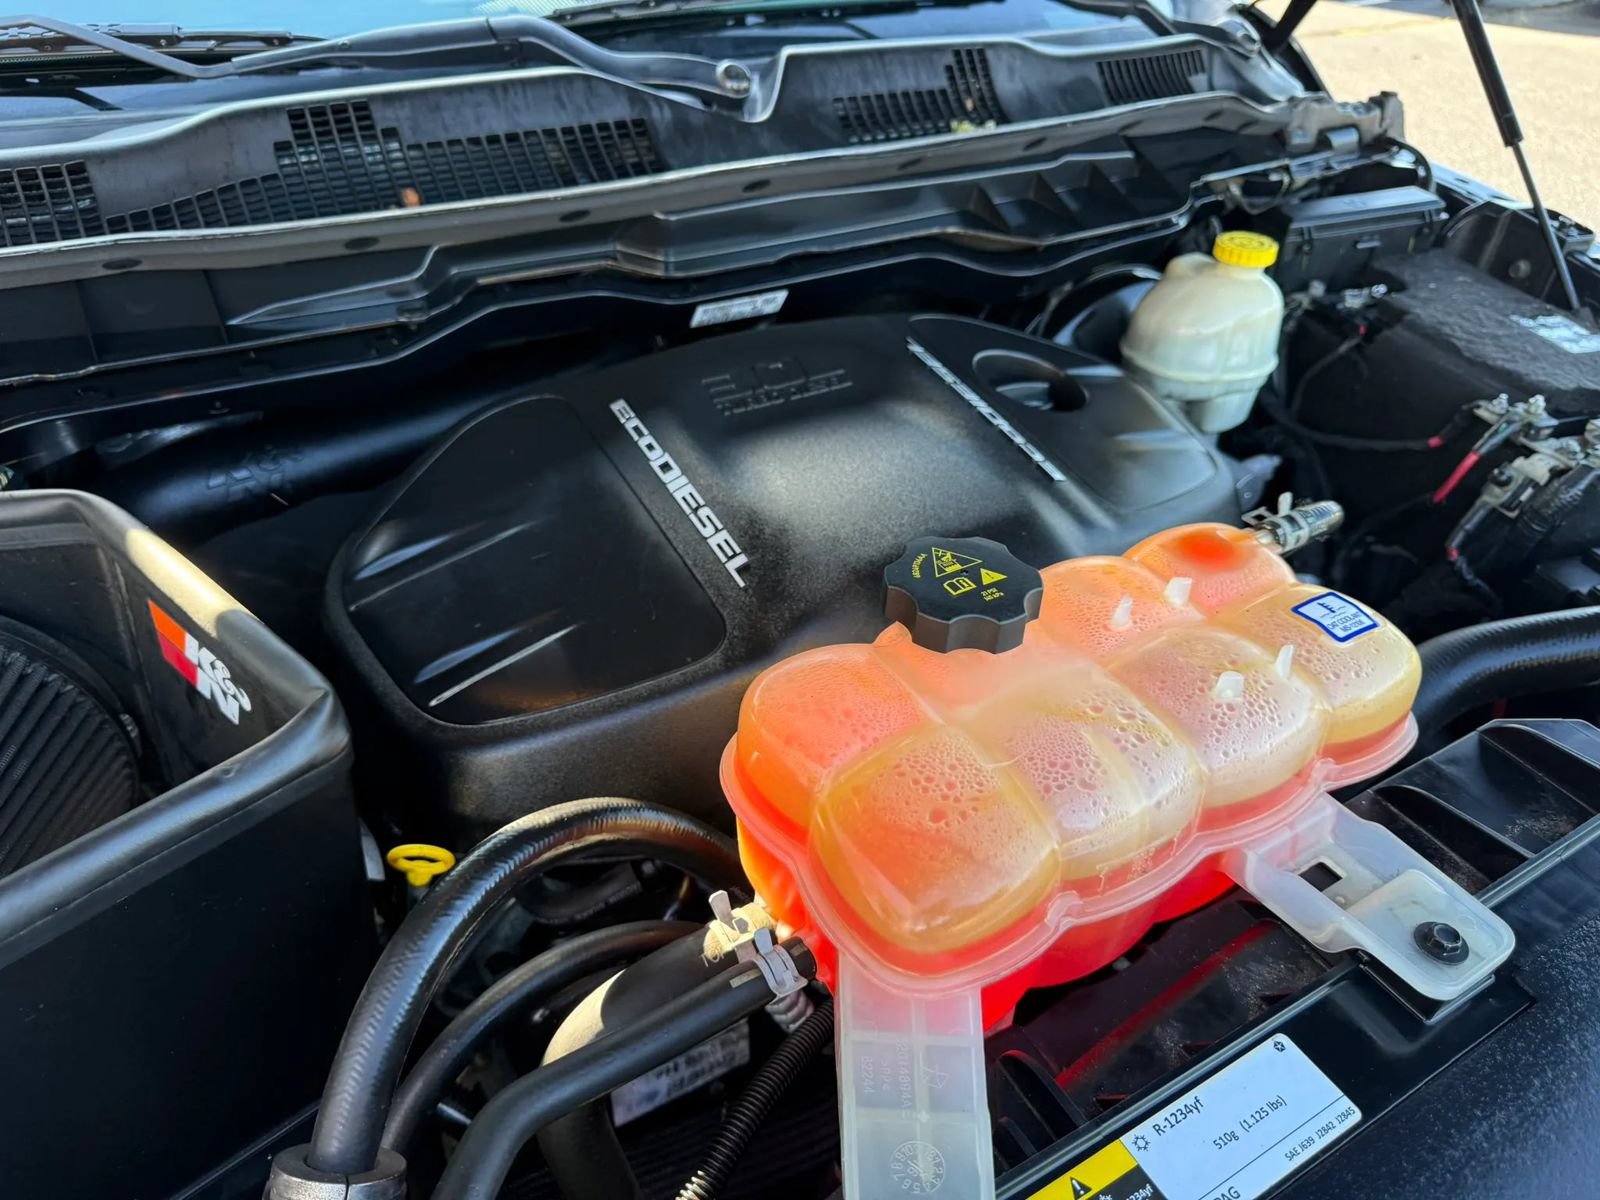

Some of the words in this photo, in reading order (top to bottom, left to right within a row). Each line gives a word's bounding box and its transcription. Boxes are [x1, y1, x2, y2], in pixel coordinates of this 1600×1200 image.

[609, 398, 749, 588] ECODIESEL
[184, 631, 252, 726] K&N
[1152, 1095, 1204, 1136] R-1234yf
[1212, 1130, 1240, 1150] 510g
[1239, 1106, 1269, 1133] (1.125
[1265, 1094, 1288, 1112] lbs)
[1284, 1146, 1301, 1161] SAE
[1297, 1135, 1316, 1152] J639
[1315, 1120, 1337, 1140] J2842
[1334, 1105, 1356, 1125] J2845
